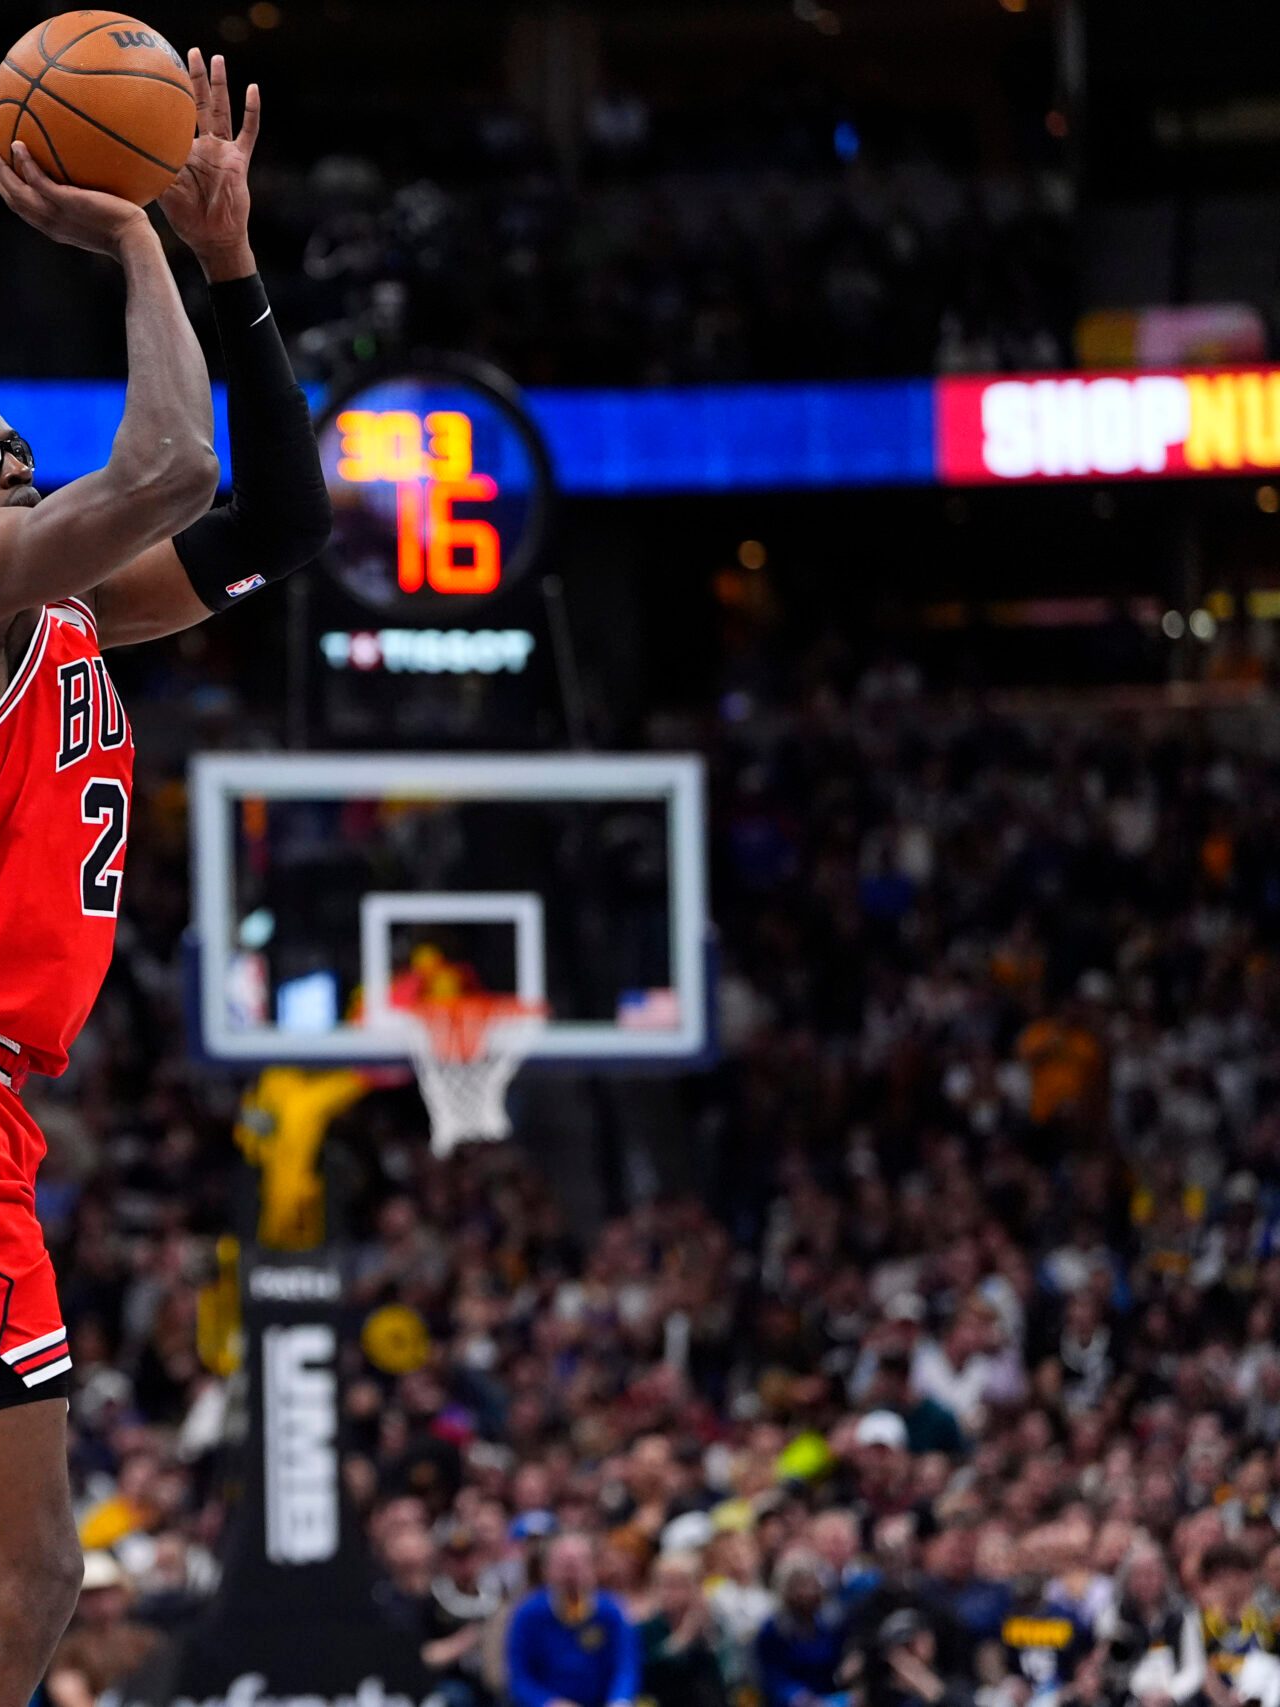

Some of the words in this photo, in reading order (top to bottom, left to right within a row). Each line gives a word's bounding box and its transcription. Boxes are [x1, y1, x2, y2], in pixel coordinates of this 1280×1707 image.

[397, 474, 501, 594] 16
[81, 777, 128, 918] 2
[269, 1324, 338, 1564] UMB
